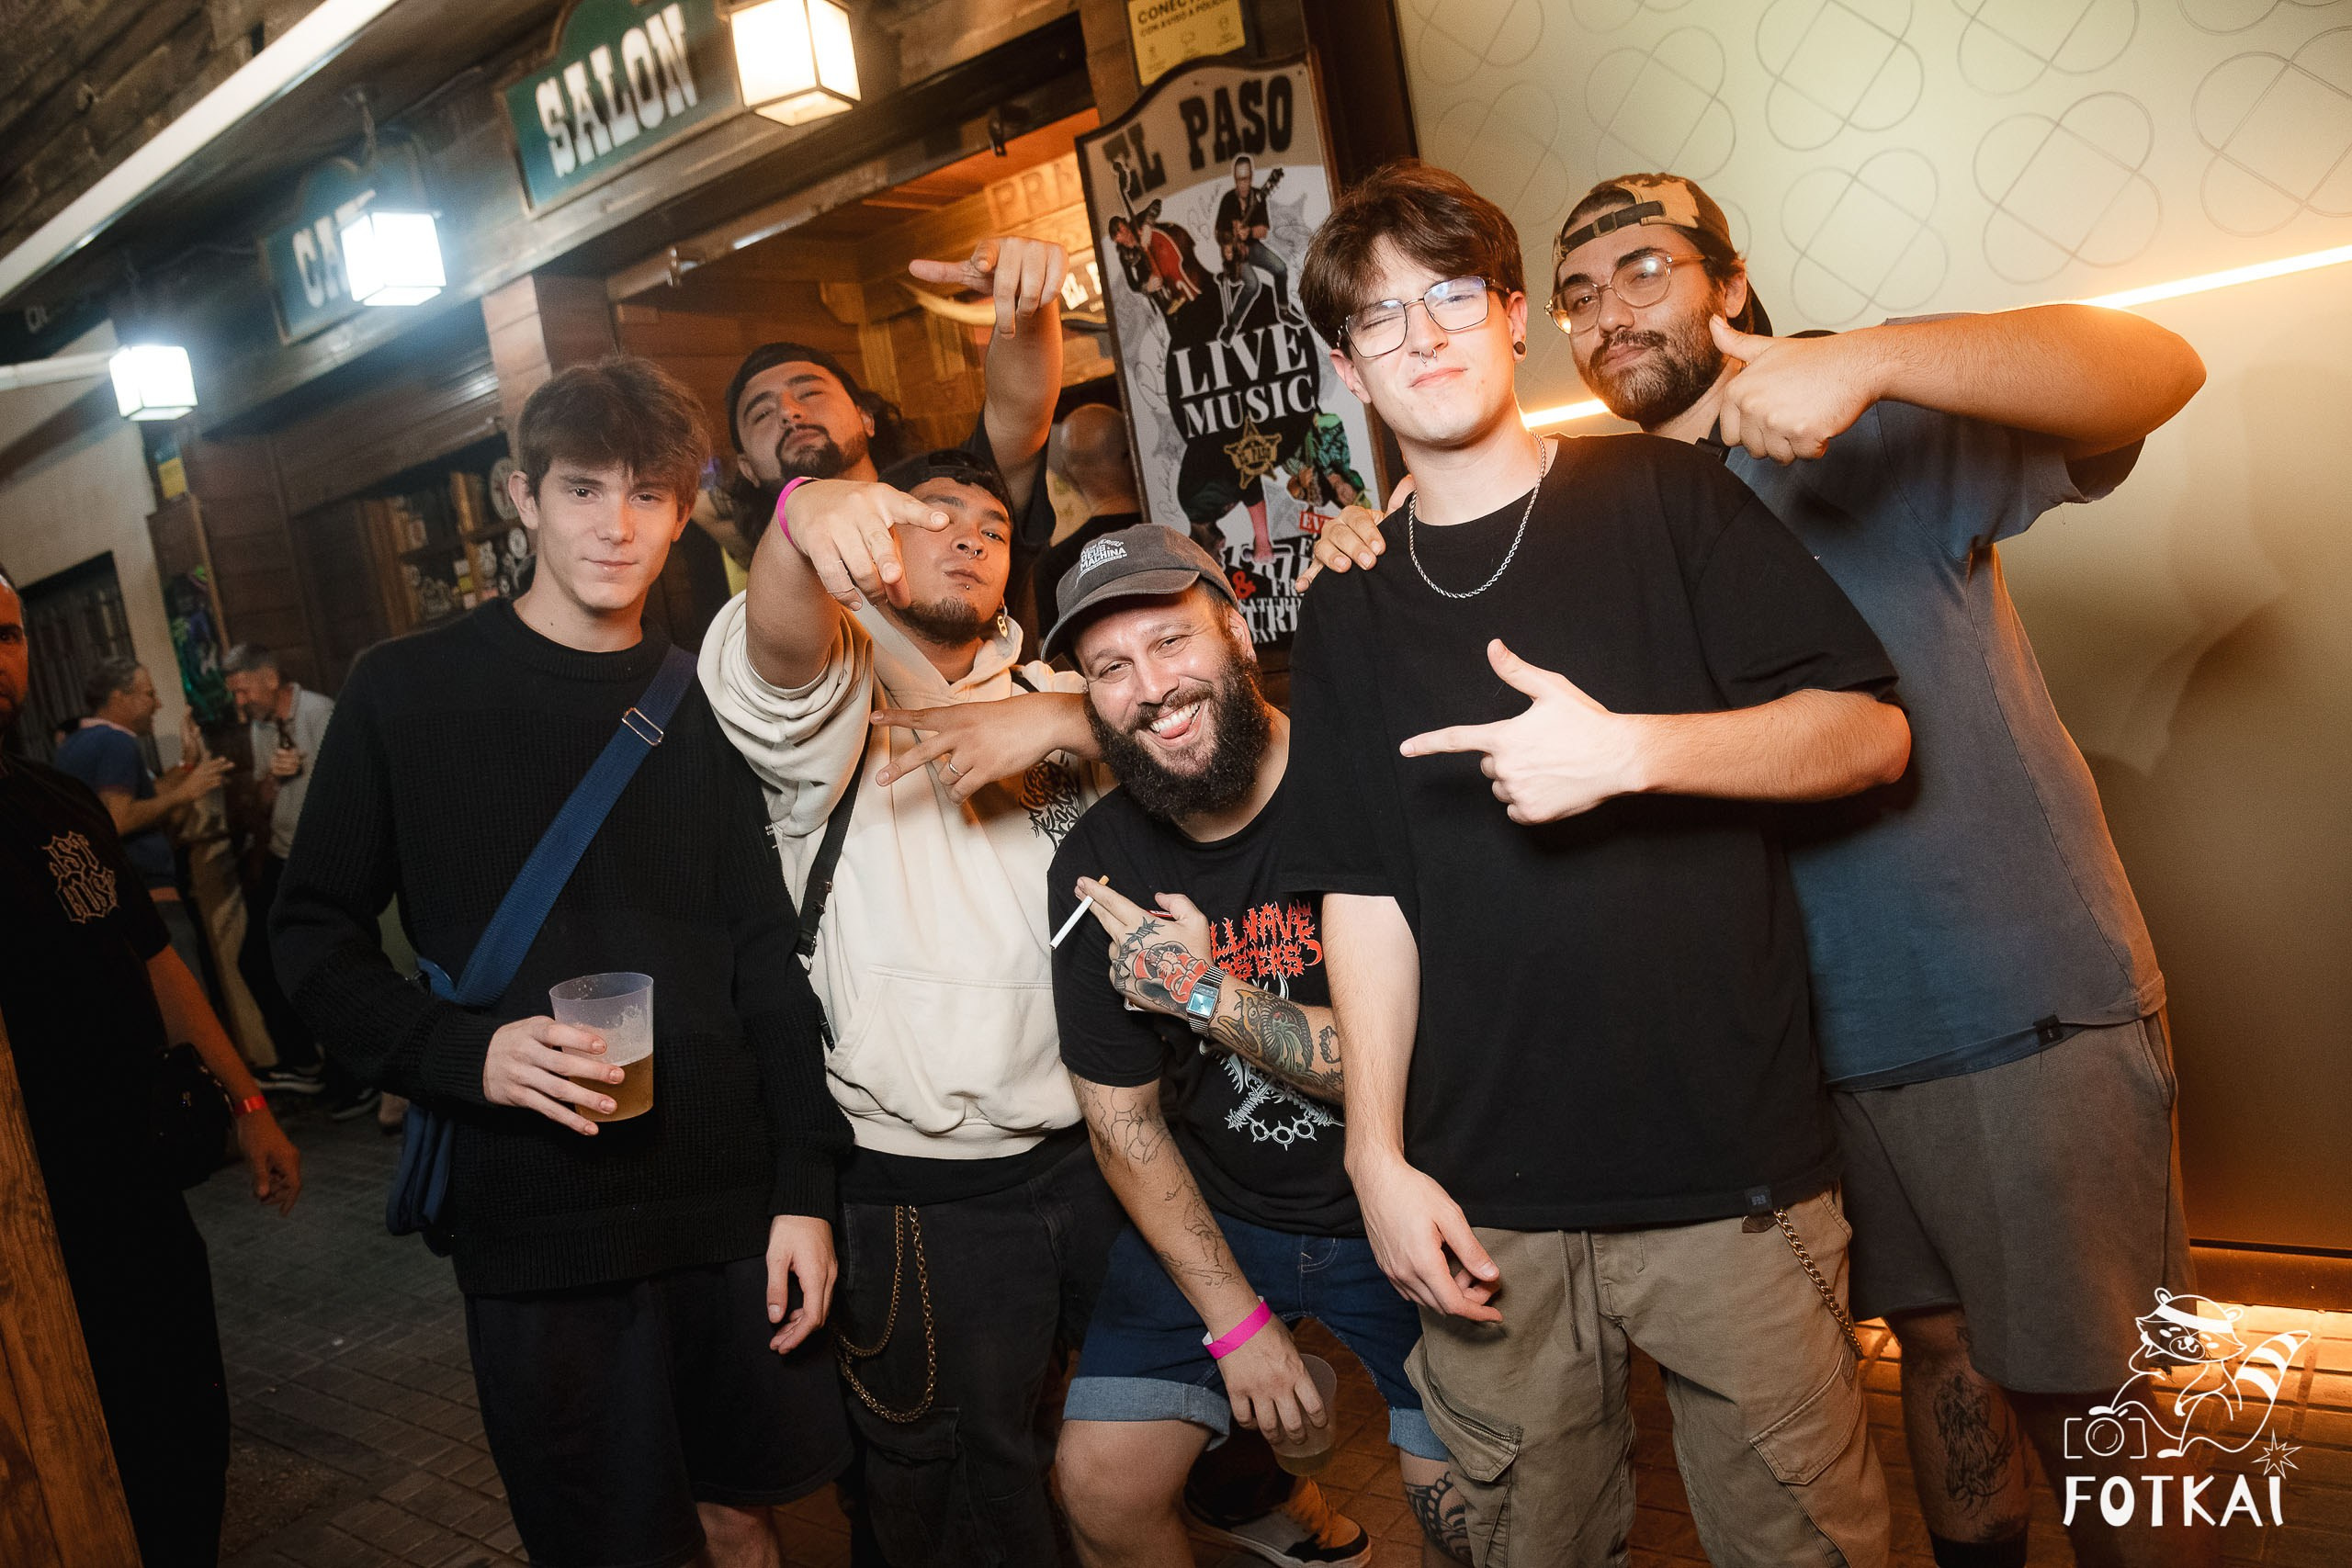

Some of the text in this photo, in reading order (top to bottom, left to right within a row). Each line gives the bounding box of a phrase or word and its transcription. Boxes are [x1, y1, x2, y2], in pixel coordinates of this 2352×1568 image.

[536, 3, 697, 178] SALON
[1103, 75, 1293, 202] EL PASO
[1172, 322, 1308, 399] LIVE
[1182, 374, 1317, 438] MUSIC
